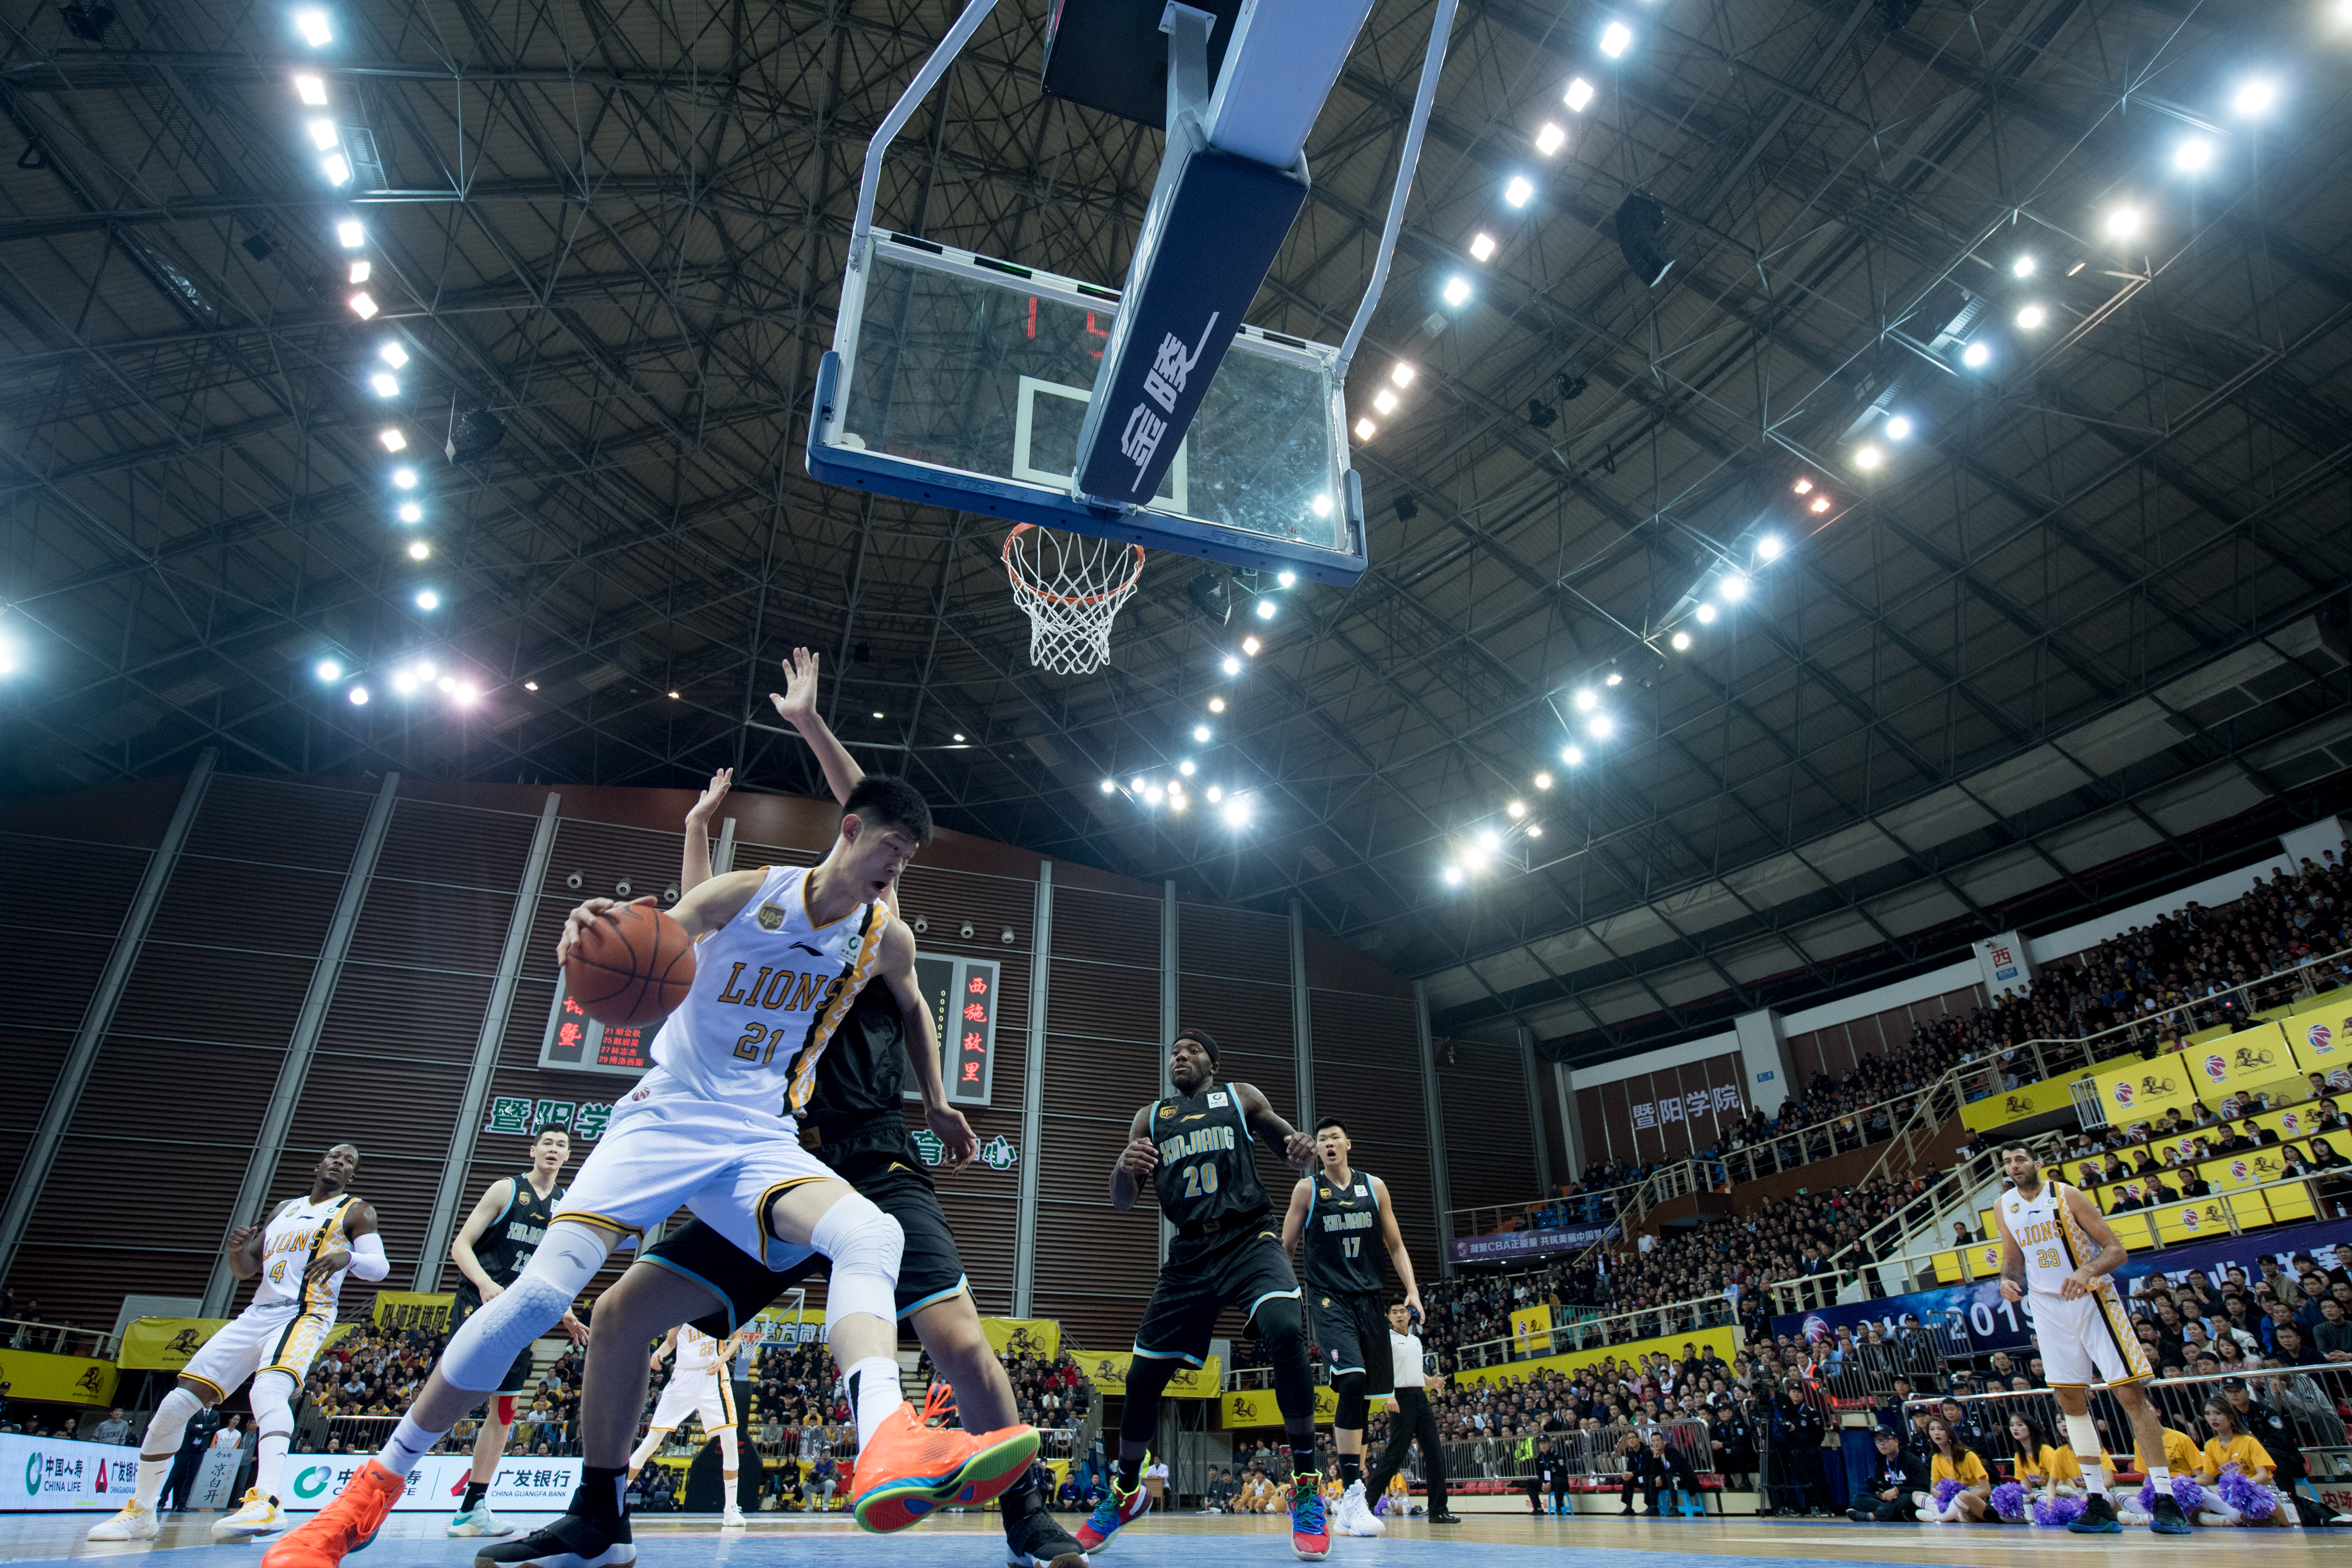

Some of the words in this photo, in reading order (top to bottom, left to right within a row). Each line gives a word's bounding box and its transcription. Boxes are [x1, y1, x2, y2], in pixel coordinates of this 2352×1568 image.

[760, 908, 783, 926] ups
[1990, 947, 2013, 968] 西
[717, 962, 848, 1011] LIONS
[961, 977, 988, 1082] 西施故里
[733, 1022, 784, 1064] 21
[1161, 1108, 1176, 1117] ups
[1632, 1084, 1739, 1130] 暨阳学院
[911, 1129, 1017, 1170] 育心
[1160, 1126, 1234, 1167] XINJIANG
[1183, 1162, 1218, 1198] 20
[1322, 1212, 1373, 1232] XINJIANG
[2016, 1219, 2064, 1248] LIONS
[263, 1228, 327, 1261] LIONS
[506, 1222, 547, 1246] XINJIA
[1342, 1237, 1361, 1258] 17
[2036, 1249, 2060, 1268] 29
[269, 1261, 288, 1284] 4
[700, 1341, 715, 1357] 25
[102, 1430, 120, 1439] LIONS
[45, 1456, 83, 1479] 中国人寿
[495, 1470, 571, 1487] 广发银行
[44, 1480, 65, 1492] CHINA
[68, 1482, 81, 1492] LIFE
